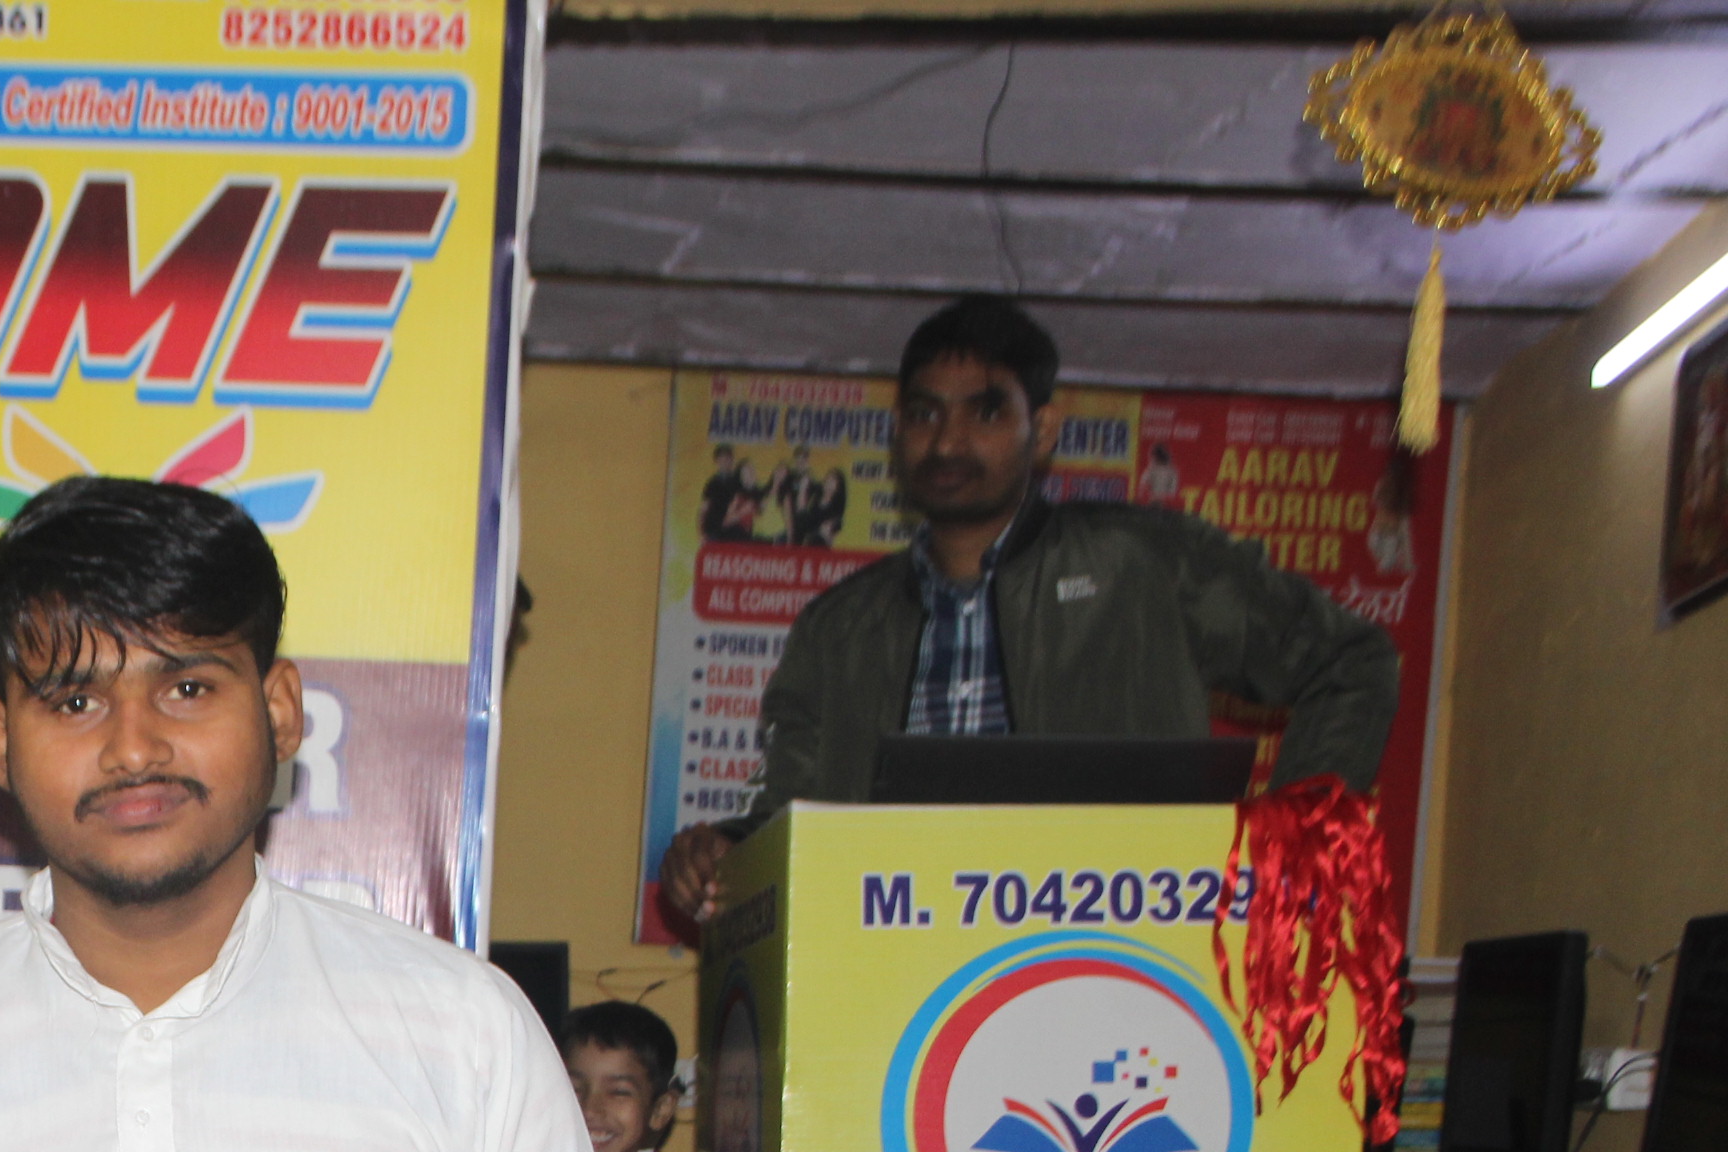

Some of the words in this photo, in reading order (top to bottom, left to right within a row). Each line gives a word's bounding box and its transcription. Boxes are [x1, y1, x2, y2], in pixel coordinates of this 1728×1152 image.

[222, 10, 468, 50] 8252866524
[3, 75, 138, 133] Certified
[138, 79, 269, 135] Institute
[292, 82, 455, 140] 9001-2015
[708, 403, 780, 442] AARAV
[783, 405, 896, 448] COMPUTE
[1216, 446, 1339, 489] AARAV
[1180, 486, 1370, 531] TAILORING
[702, 552, 798, 582] REASONING
[708, 588, 735, 614] ALL
[708, 633, 769, 659] SPOKEN
[862, 872, 931, 927] M.
